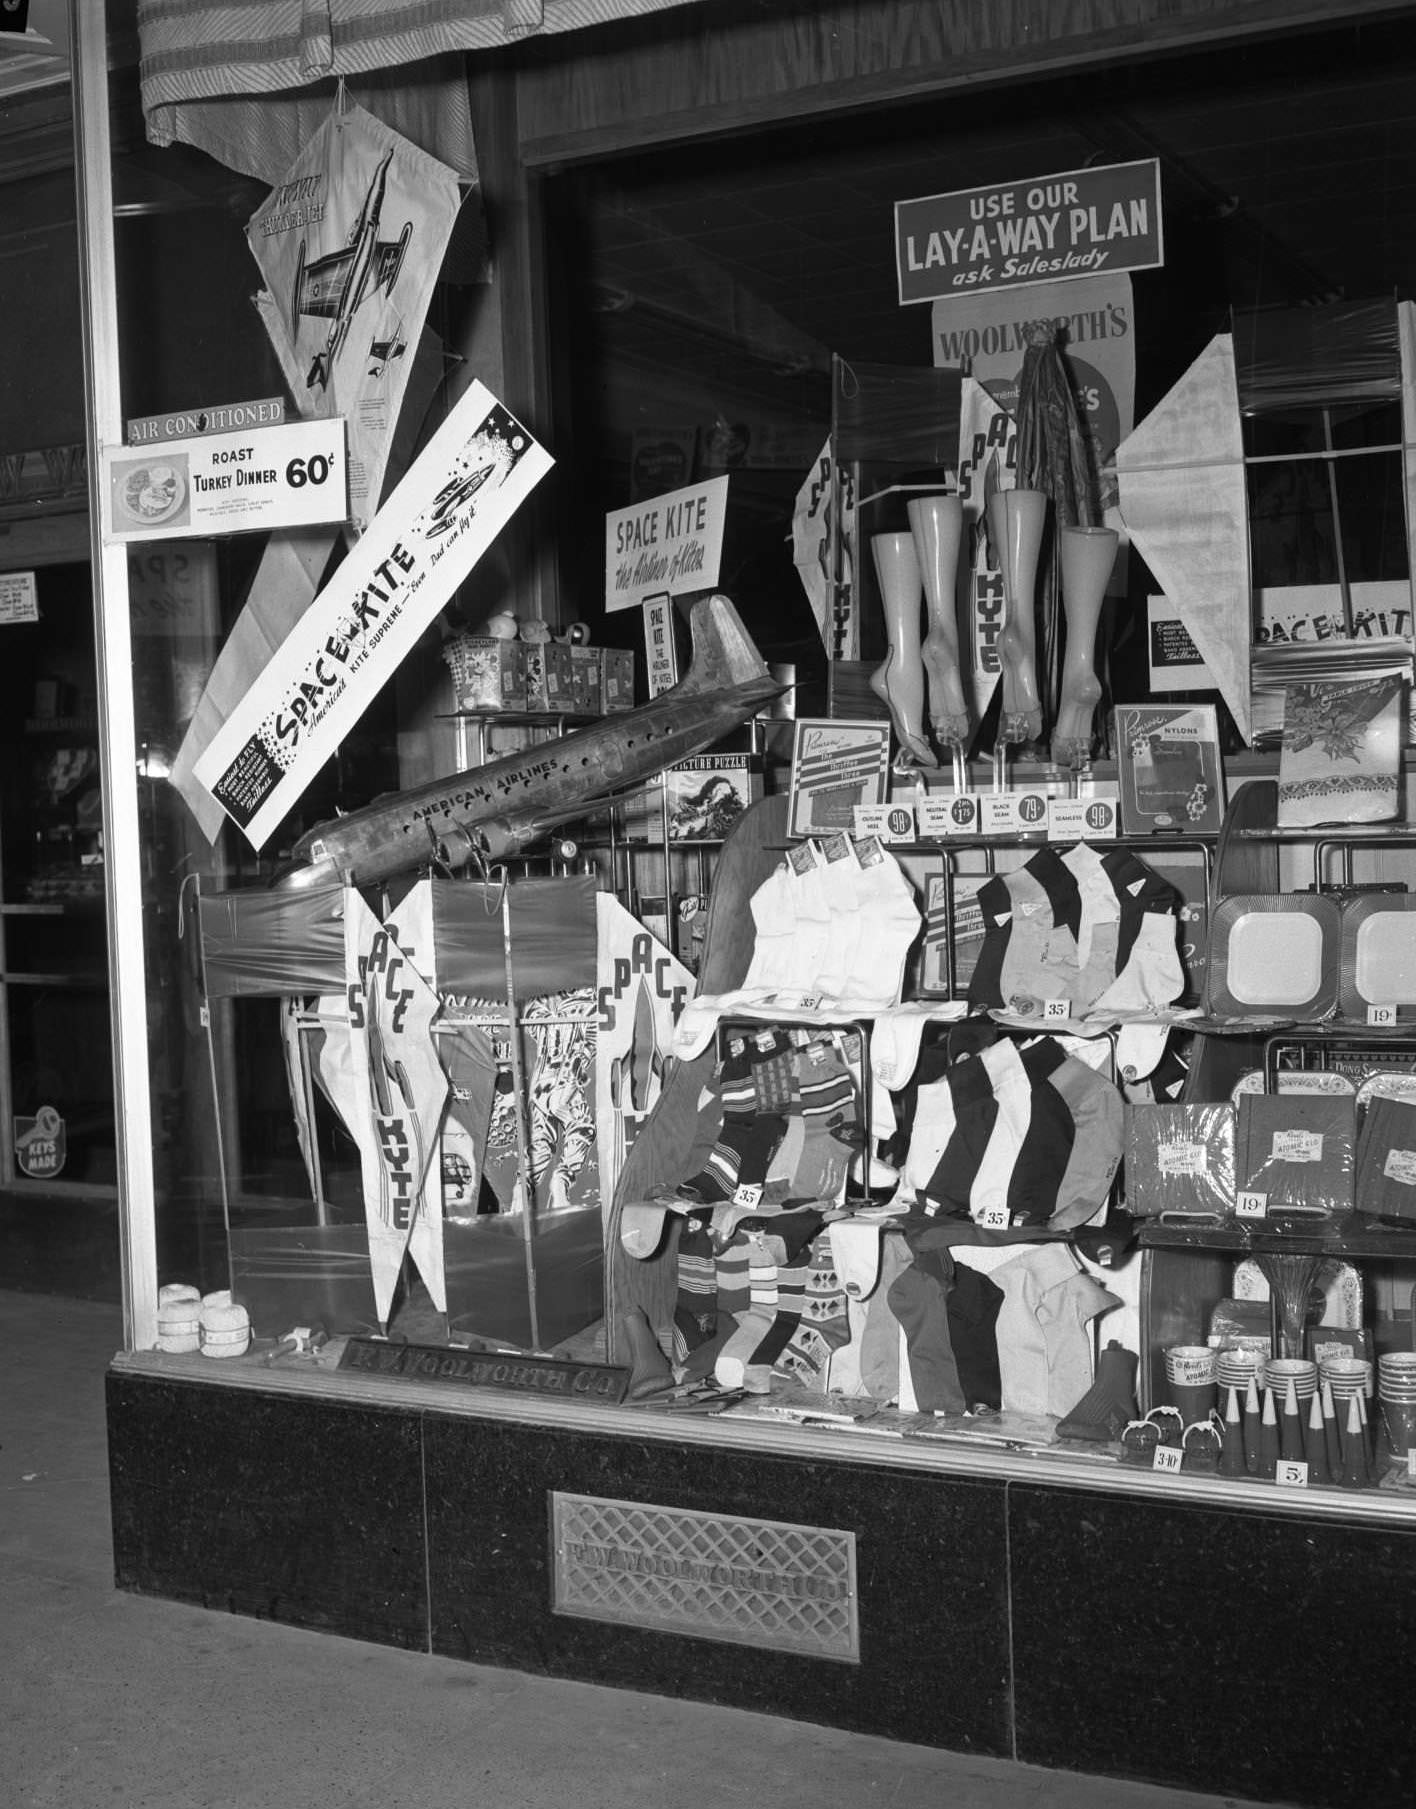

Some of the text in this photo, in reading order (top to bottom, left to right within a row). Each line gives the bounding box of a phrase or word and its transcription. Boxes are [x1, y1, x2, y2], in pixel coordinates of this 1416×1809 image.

[969, 182, 1079, 220] USE OUR
[906, 198, 1149, 272] LAY-A-WAY PLAN
[952, 247, 1109, 286] ask Saleslady
[131, 422, 159, 441] AIR
[193, 473, 233, 493] TURKEY
[236, 468, 278, 487] DINNER
[286, 452, 334, 489] 60¢
[212, 448, 254, 464] ROAST
[615, 496, 708, 555] SPACE KITE
[350, 649, 370, 674] KITE
[430, 542, 445, 567] Dad
[446, 530, 459, 548] can
[1350, 608, 1411, 639] KIT
[276, 542, 416, 747] SPACE KITE
[243, 741, 257, 759] FLY
[1164, 727, 1199, 735] NYLONS
[714, 755, 748, 769] PUZZLE
[413, 758, 559, 822] AMERICAN AIRLINES
[28, 1140, 56, 1156] KEYS
[28, 1154, 56, 1170] MADE
[377, 1119, 410, 1230] KYTE
